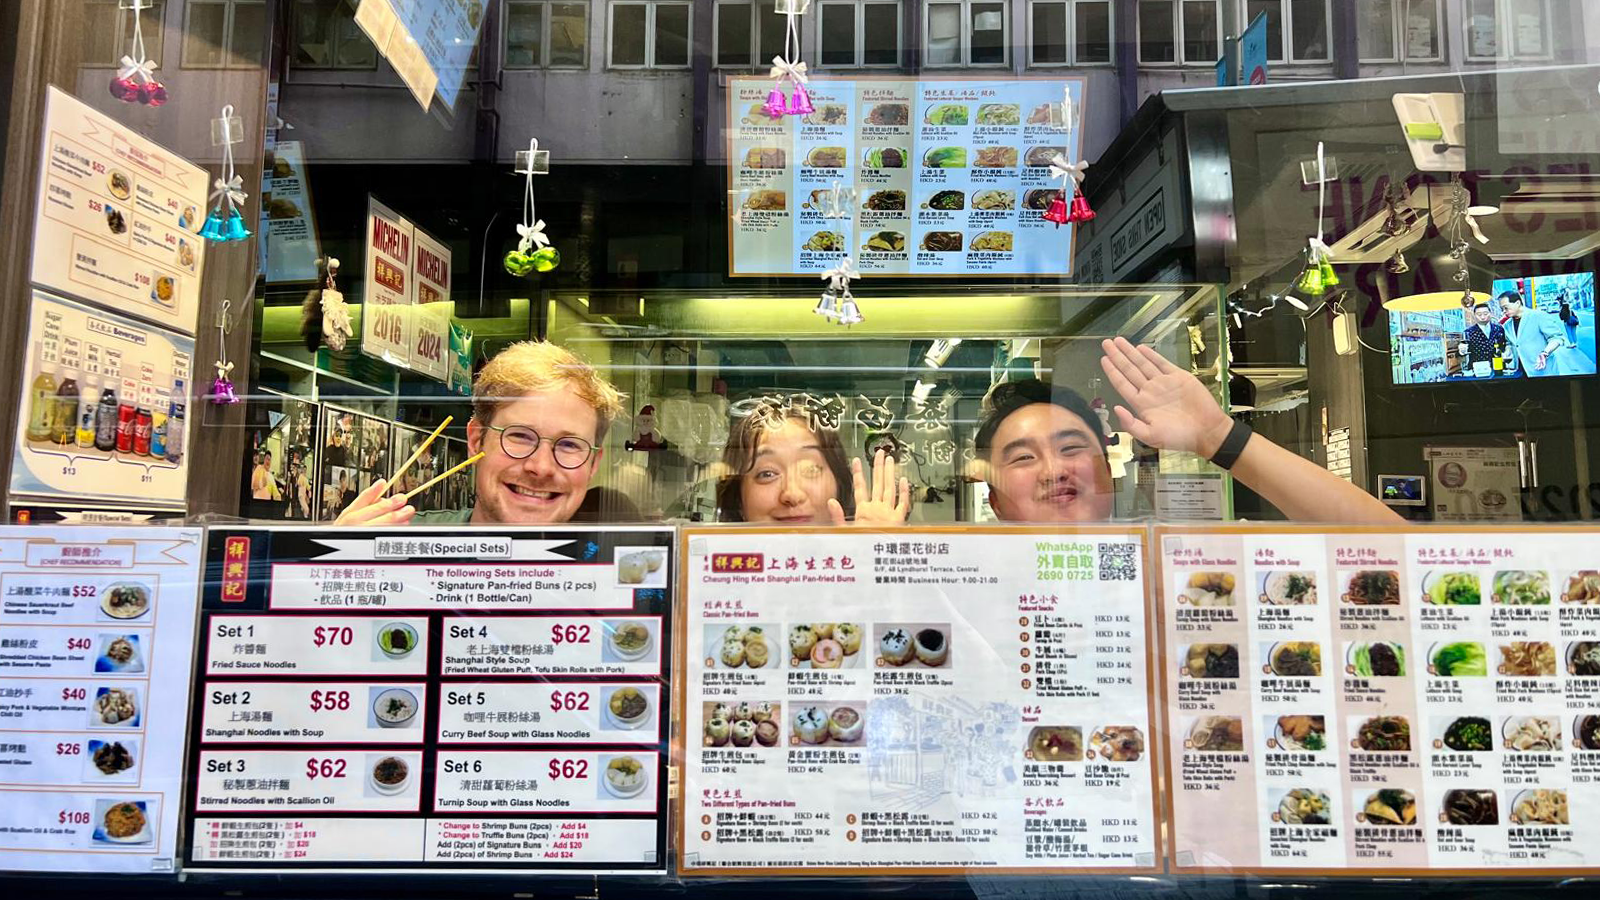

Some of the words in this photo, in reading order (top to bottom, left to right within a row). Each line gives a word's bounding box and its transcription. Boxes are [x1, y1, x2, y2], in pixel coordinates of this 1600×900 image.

[373, 215, 409, 266] MICHELIN
[417, 245, 448, 289] MICHELIN
[373, 309, 401, 345] 2016
[417, 328, 440, 362] 2024
[62, 466, 76, 475] $13
[141, 475, 152, 483] $11
[480, 542, 509, 554] Sets)
[1036, 542, 1093, 553] WhatsApp
[226, 541, 245, 596] 祥興記
[715, 556, 761, 570] 祥興記
[767, 555, 855, 570] 上海生煎包
[426, 569, 444, 577] The
[447, 569, 492, 578] following
[494, 569, 516, 578] Sets
[733, 575, 749, 584] Hing
[767, 575, 800, 584] Shanghai
[1037, 570, 1063, 580] 2690
[1067, 570, 1094, 580] 0725
[73, 585, 96, 597] $52
[437, 582, 485, 591] Signature
[488, 582, 532, 590] Pan-fried
[535, 582, 560, 590] Buns
[563, 582, 573, 592] (2
[575, 582, 596, 592] pcs)
[321, 595, 342, 605] 飲品
[345, 595, 354, 606] (1
[436, 594, 462, 602] Drink
[465, 594, 474, 604] (1
[477, 594, 532, 604] Bottle/Can)
[218, 625, 242, 637] Set
[247, 626, 254, 637] 1
[314, 626, 353, 647] $70
[450, 626, 474, 638] Set
[479, 627, 487, 638] 4
[551, 624, 591, 644] $62
[68, 638, 91, 650] $40
[445, 656, 484, 665] Shanghai
[486, 656, 507, 665] Style
[509, 656, 530, 665] Soup
[62, 688, 86, 700] $40
[212, 692, 237, 704] Set
[242, 692, 251, 704] 2
[447, 692, 472, 705] Set
[476, 692, 485, 704] 5
[310, 690, 350, 712] $58
[550, 691, 590, 712] $62
[206, 728, 245, 737] Shanghai
[247, 728, 281, 737] Noodles
[302, 729, 324, 738] Soup
[442, 730, 465, 740] Curry
[488, 730, 509, 740] Soup
[57, 743, 80, 755] $26
[207, 760, 233, 772] Set
[236, 760, 245, 772] 3
[306, 758, 347, 780] $62
[444, 760, 469, 773] Set
[473, 760, 482, 773] 6
[548, 759, 589, 780] $62
[200, 797, 229, 805] Stirred
[231, 797, 265, 805] Noodles
[438, 799, 464, 808] Turnip
[466, 799, 488, 808] Soup
[59, 811, 90, 824] $108
[444, 822, 471, 830] Change
[482, 823, 508, 831] Shrimp
[487, 841, 521, 850] Signature
[487, 851, 512, 859] Shrimp
